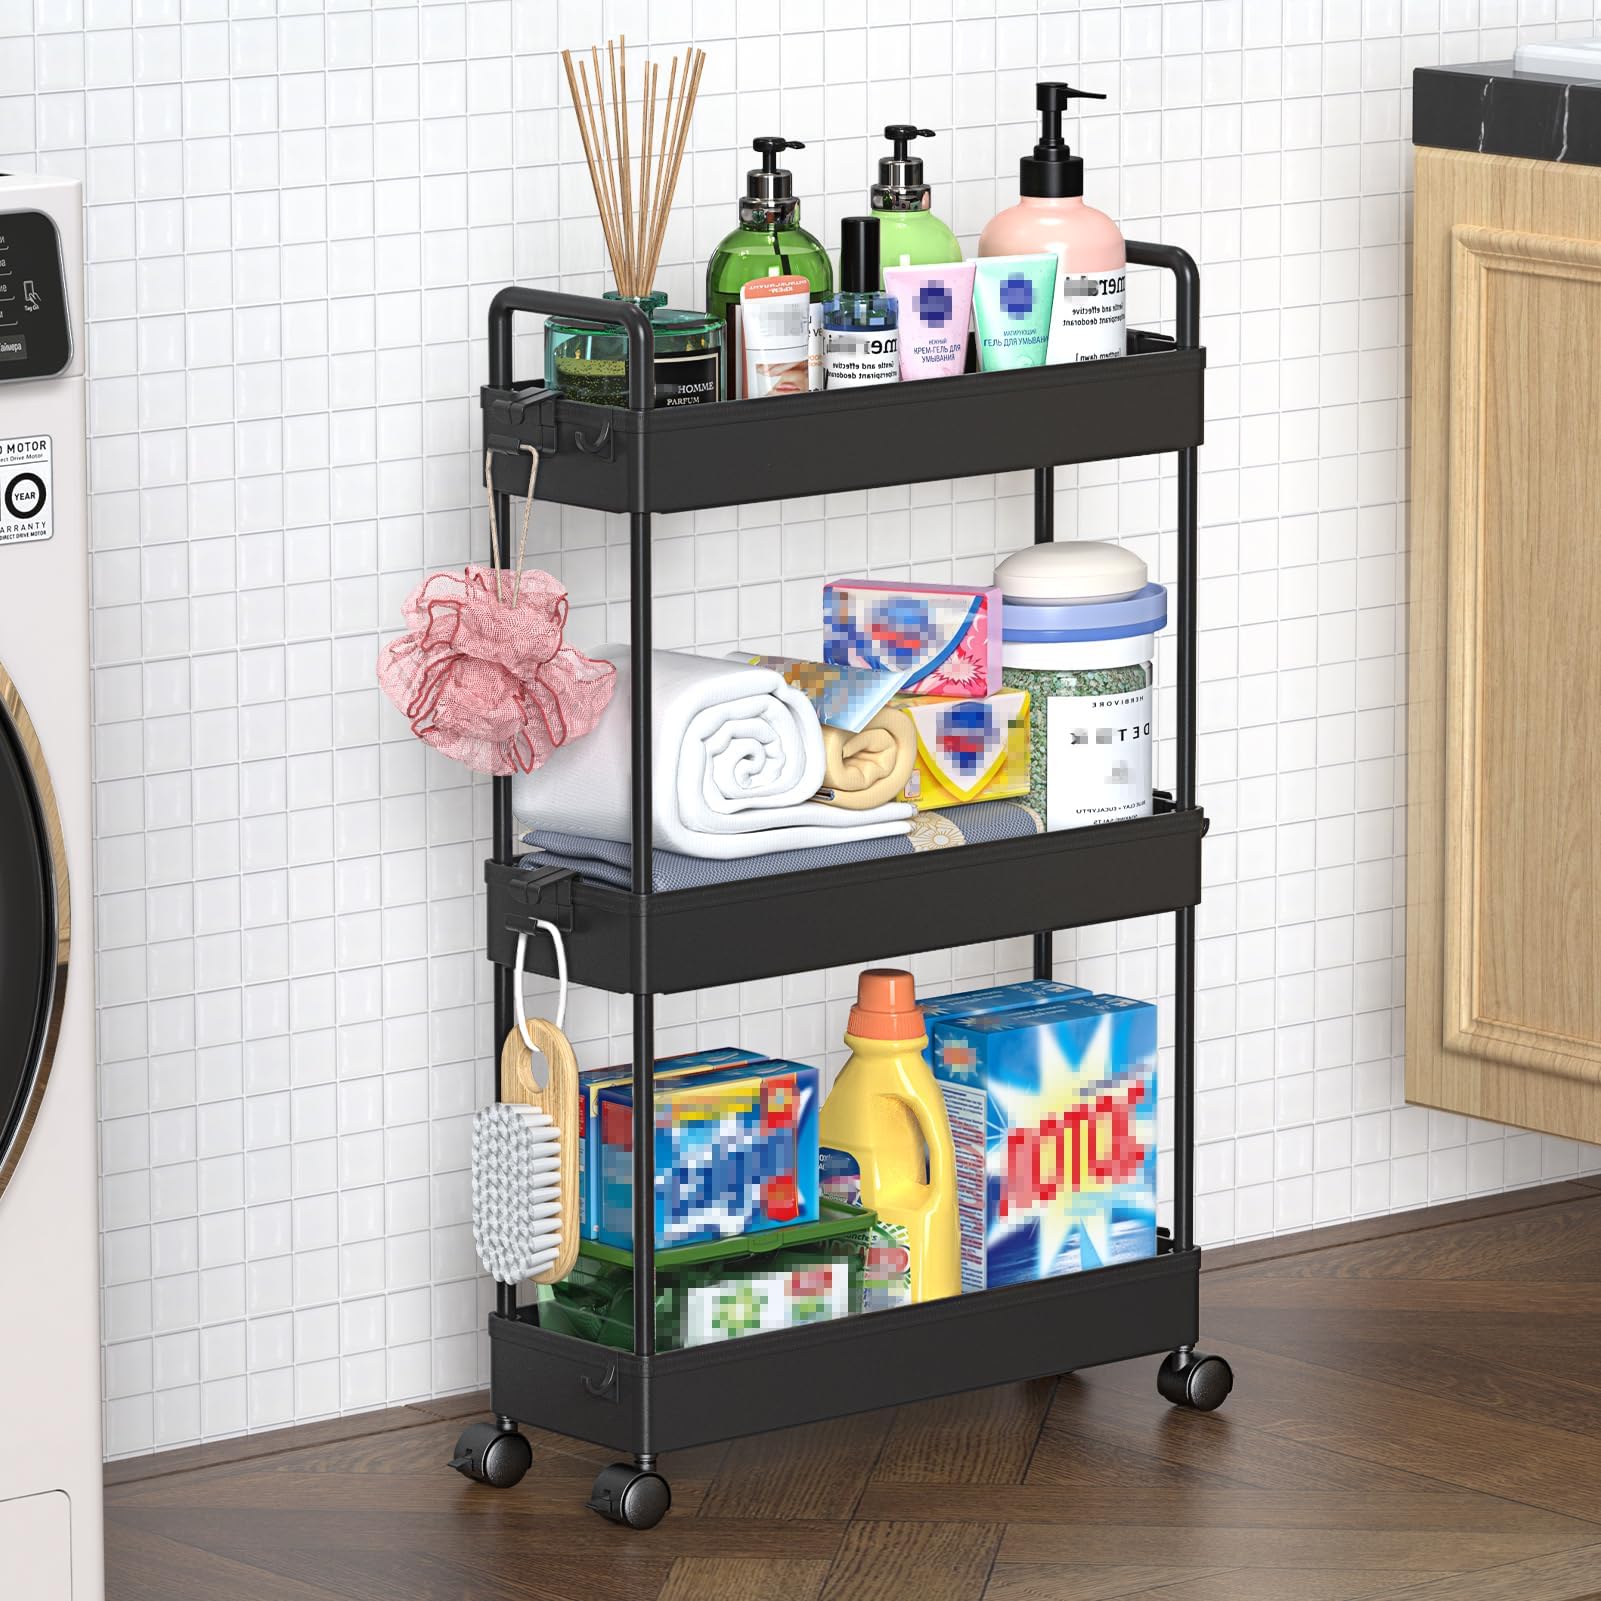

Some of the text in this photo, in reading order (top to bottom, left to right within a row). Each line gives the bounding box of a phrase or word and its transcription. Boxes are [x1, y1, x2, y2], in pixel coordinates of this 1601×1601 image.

[984, 339, 1002, 347] ГЕЛЬ
[1003, 338, 1018, 347] ДЛЯ
[949, 344, 961, 353] ДЛЯ
[921, 353, 956, 363] УМЫВАНИЯ
[677, 381, 714, 394] HOMME
[666, 396, 700, 406] PARFUM
[7, 440, 47, 454] MOTOR
[15, 491, 36, 501] YEAR
[0, 521, 46, 533] ARRANTY
